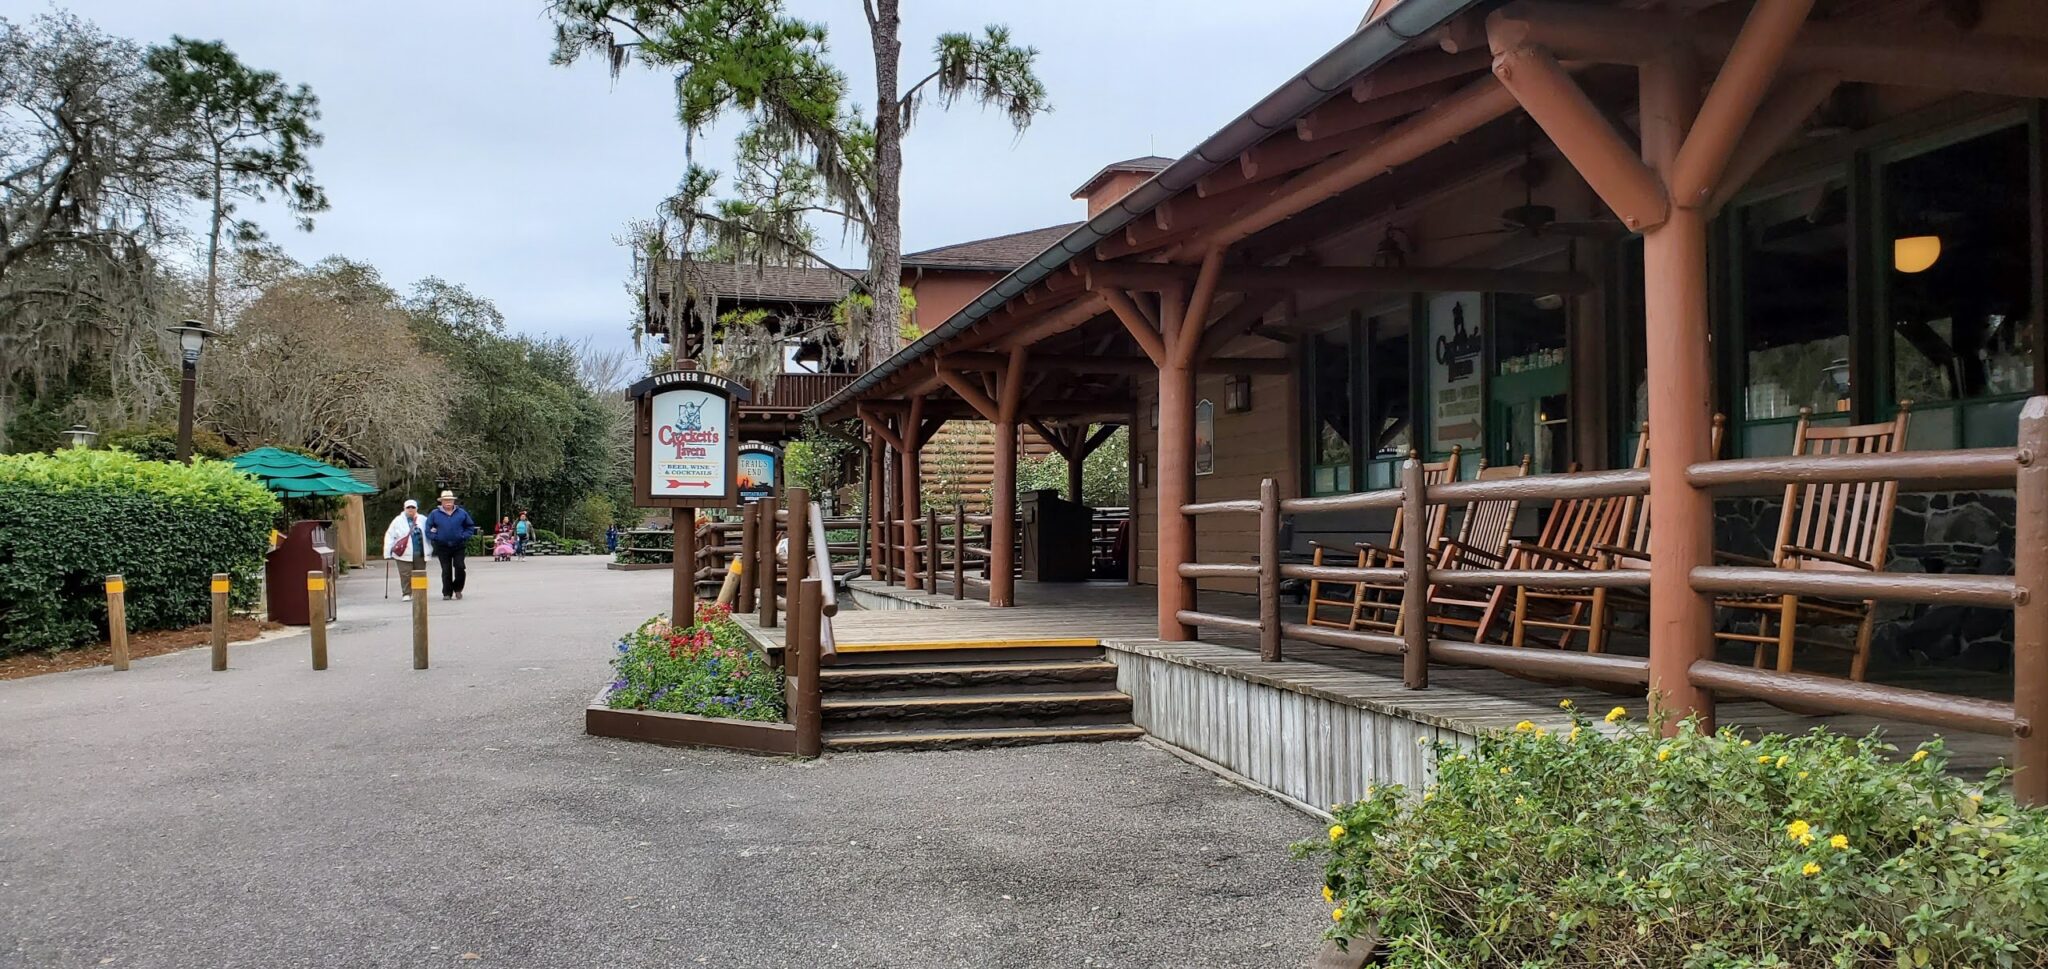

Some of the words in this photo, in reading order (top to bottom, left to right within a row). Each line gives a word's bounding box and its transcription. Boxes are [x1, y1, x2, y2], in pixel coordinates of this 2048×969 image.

[654, 372, 698, 386] PIONEER
[703, 374, 728, 389] HALL
[658, 425, 720, 447] Crockett's
[675, 442, 706, 459] Tavern
[747, 468, 762, 476] END
